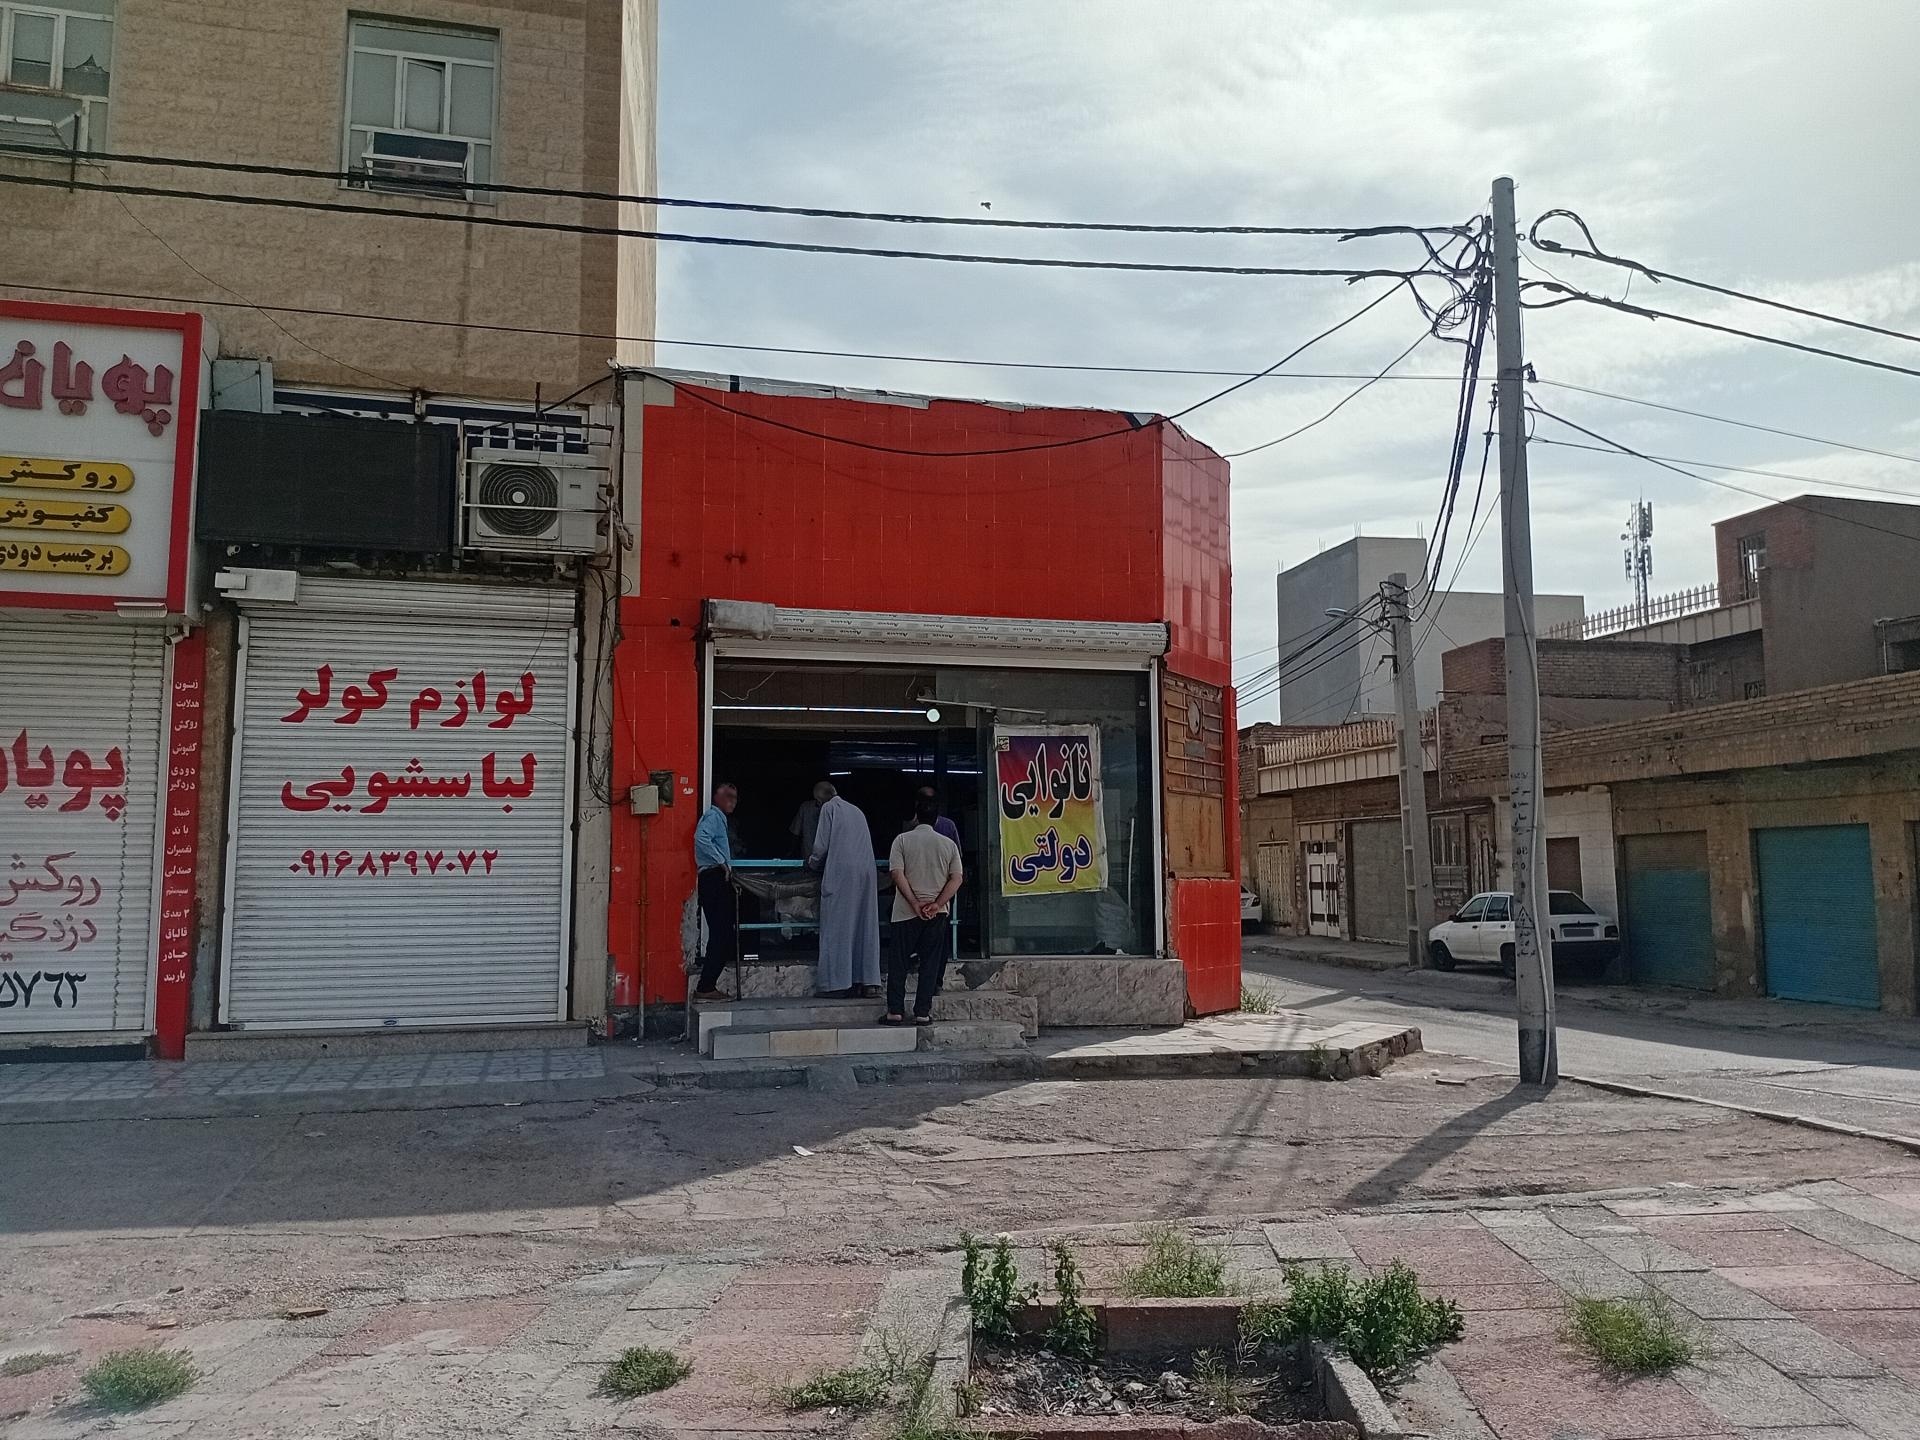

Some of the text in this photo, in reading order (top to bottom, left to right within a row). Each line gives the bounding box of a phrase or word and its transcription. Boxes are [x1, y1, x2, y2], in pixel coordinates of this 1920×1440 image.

[0, 460, 117, 489] روکش
[0, 500, 115, 529] کفپوش
[47, 548, 114, 571] برچسب
[280, 663, 537, 730] لوازم کولر
[174, 720, 198, 732] روکش
[0, 728, 126, 822] پویا
[170, 765, 196, 777] دودی
[1001, 743, 1092, 820] نانوایی
[0, 850, 102, 906] روکش
[1009, 825, 1093, 884] دولتی
[0, 911, 98, 961] دزدگی
